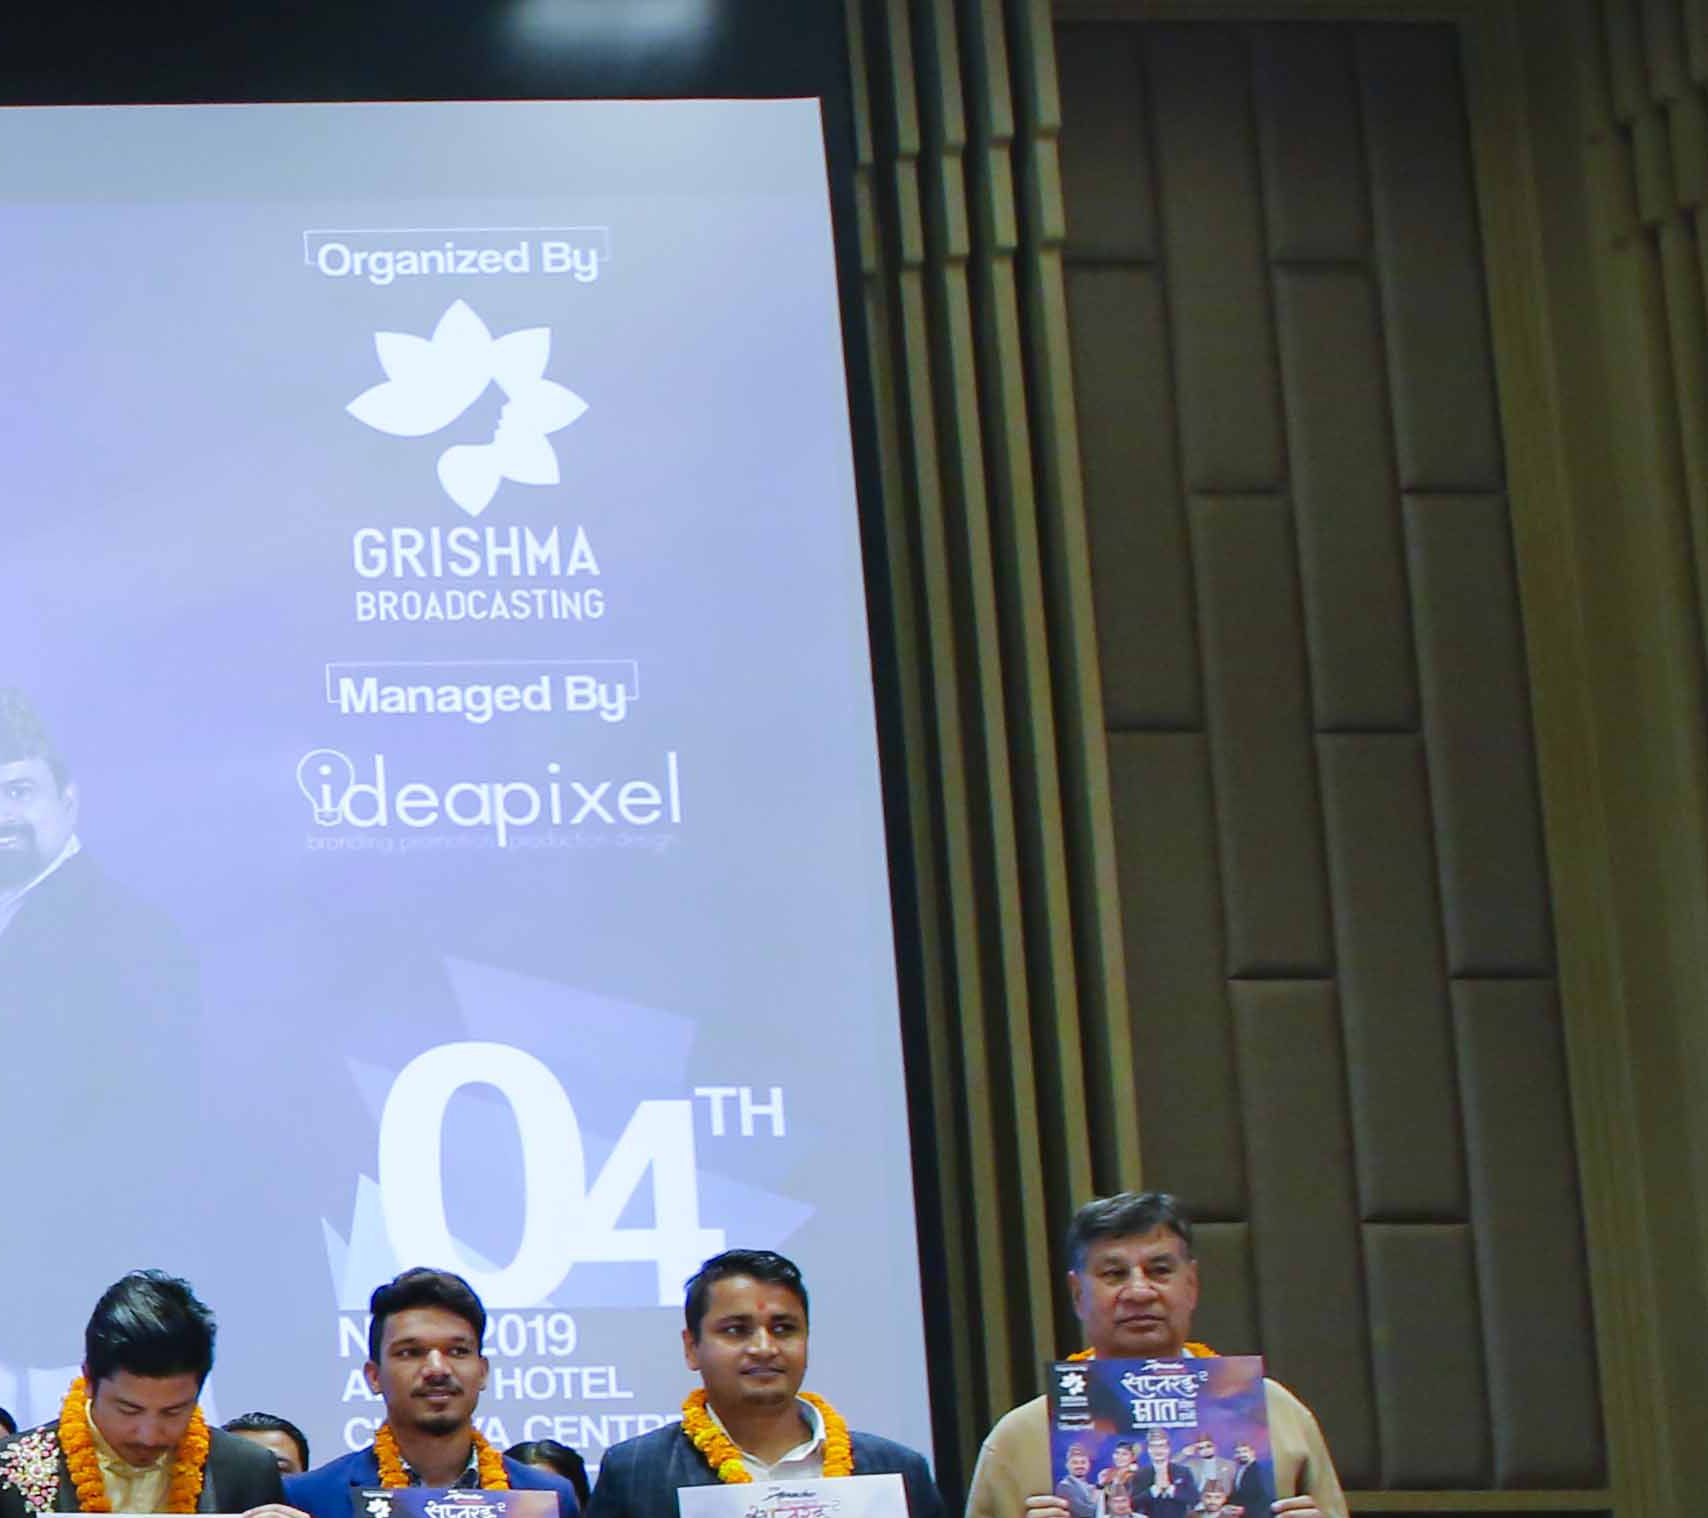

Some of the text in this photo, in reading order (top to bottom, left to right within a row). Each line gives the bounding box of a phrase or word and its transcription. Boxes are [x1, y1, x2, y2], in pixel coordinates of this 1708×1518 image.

[317, 241, 599, 285] Organized By
[352, 526, 600, 578] GRISHMA
[354, 588, 605, 623] BROADCASTING
[338, 675, 627, 724] Managed By
[317, 750, 682, 847] ideapixel
[481, 1312, 577, 1359] 2019
[495, 1366, 635, 1400] HOTEL
[1130, 1398, 1179, 1422] सात
